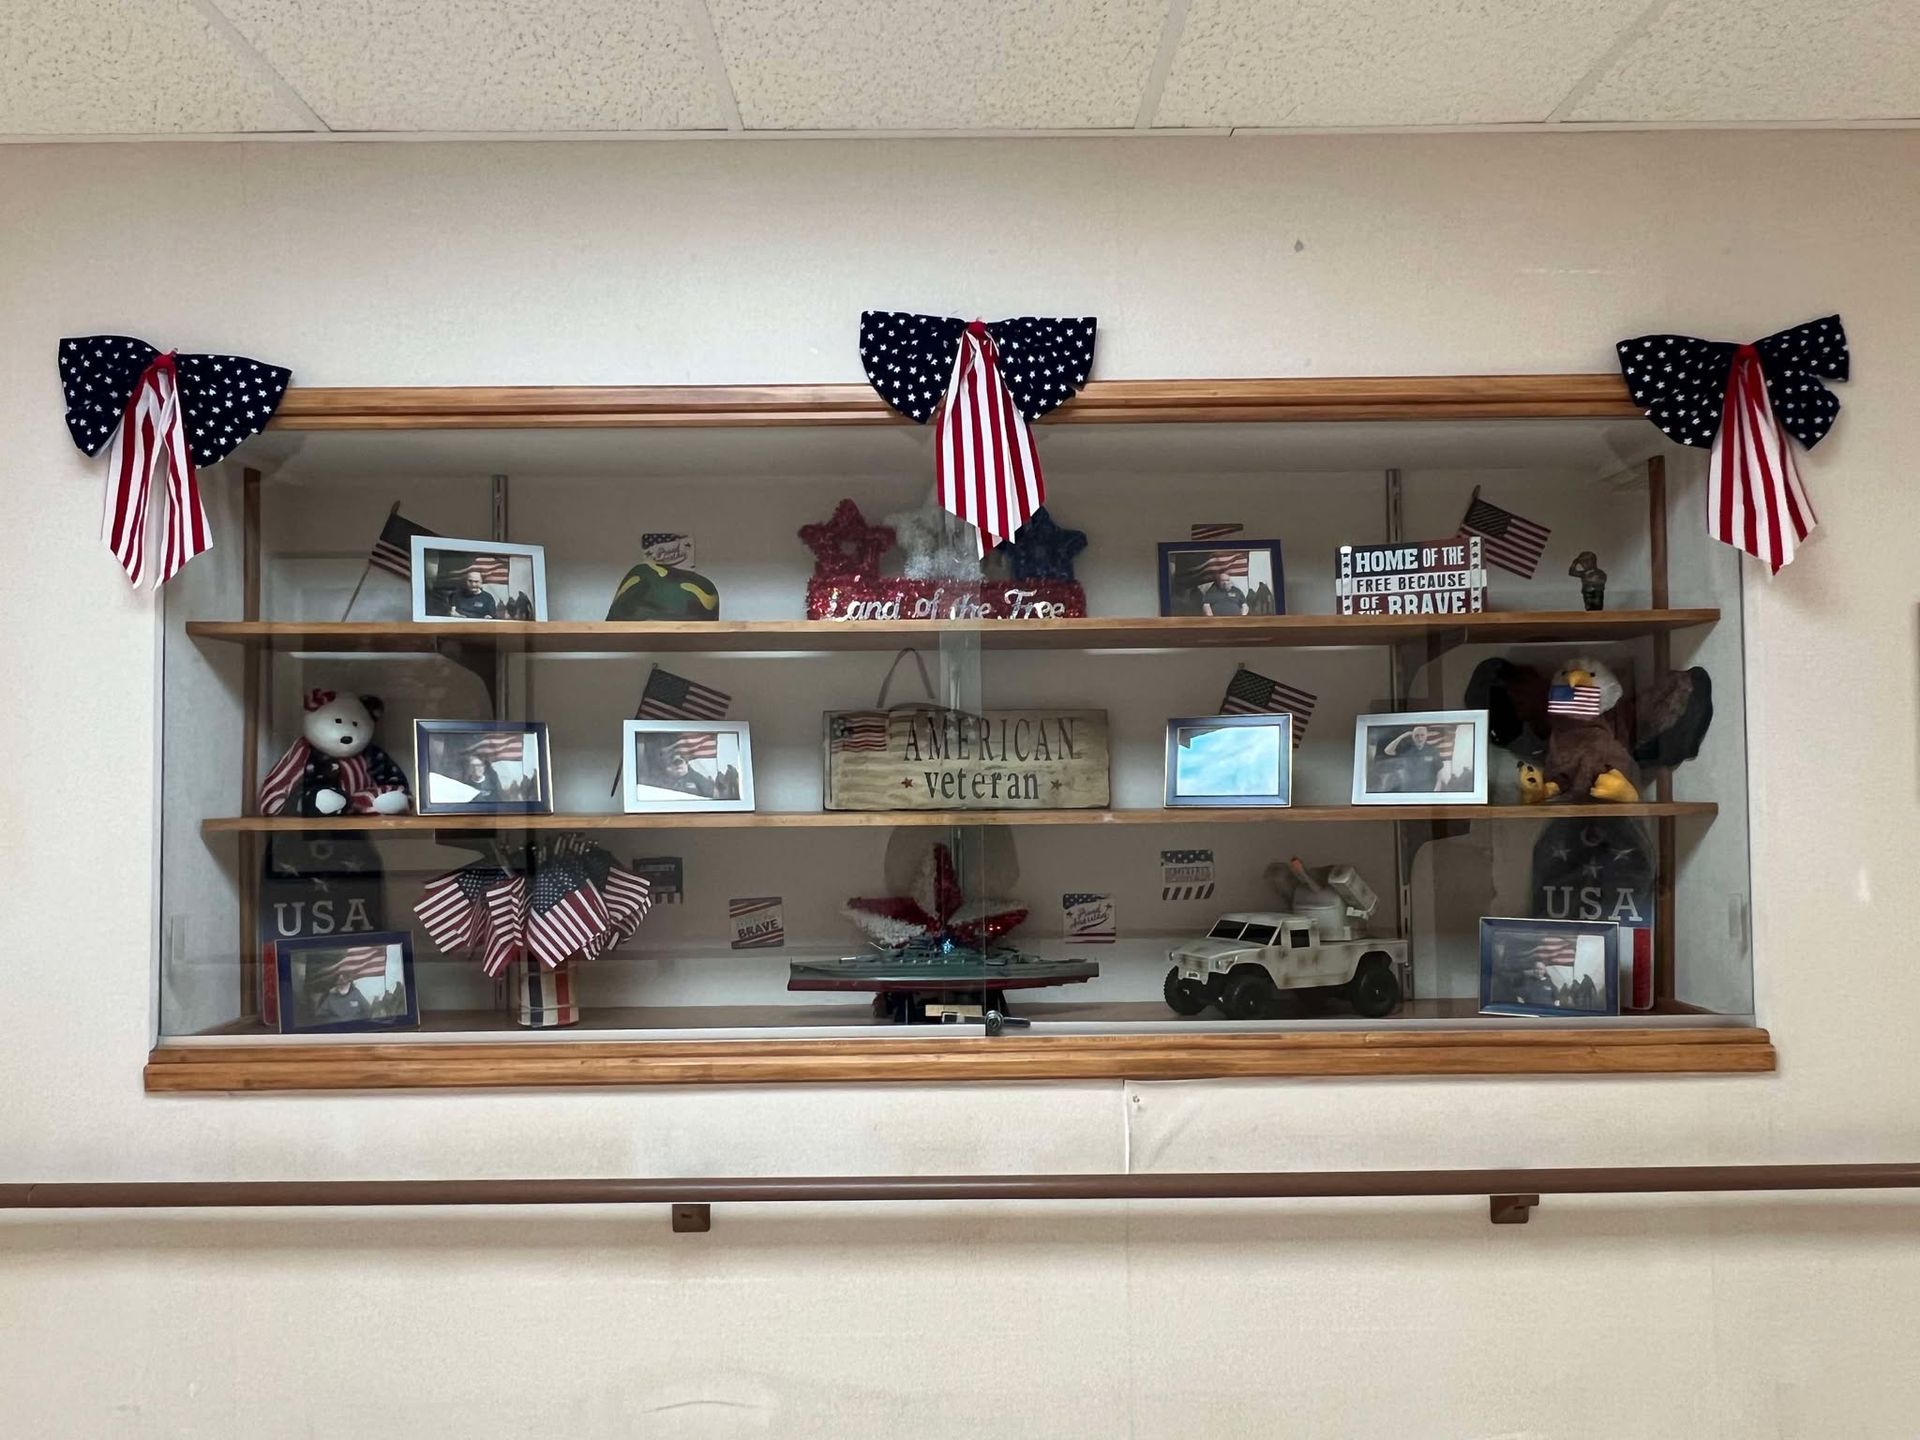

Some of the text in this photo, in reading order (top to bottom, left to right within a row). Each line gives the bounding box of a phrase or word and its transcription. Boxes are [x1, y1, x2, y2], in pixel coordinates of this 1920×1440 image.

[1355, 545, 1465, 573] HOME OF THE
[1356, 572, 1467, 593] FREE BECAUSE
[821, 587, 1067, 622] Land of the Free
[1359, 591, 1467, 615] OF BRAVE
[904, 716, 1082, 762] AMERICAN
[924, 767, 1041, 800] veteran
[273, 898, 375, 937] USA
[1542, 885, 1644, 922] USA
[737, 918, 780, 940] BRAVE
